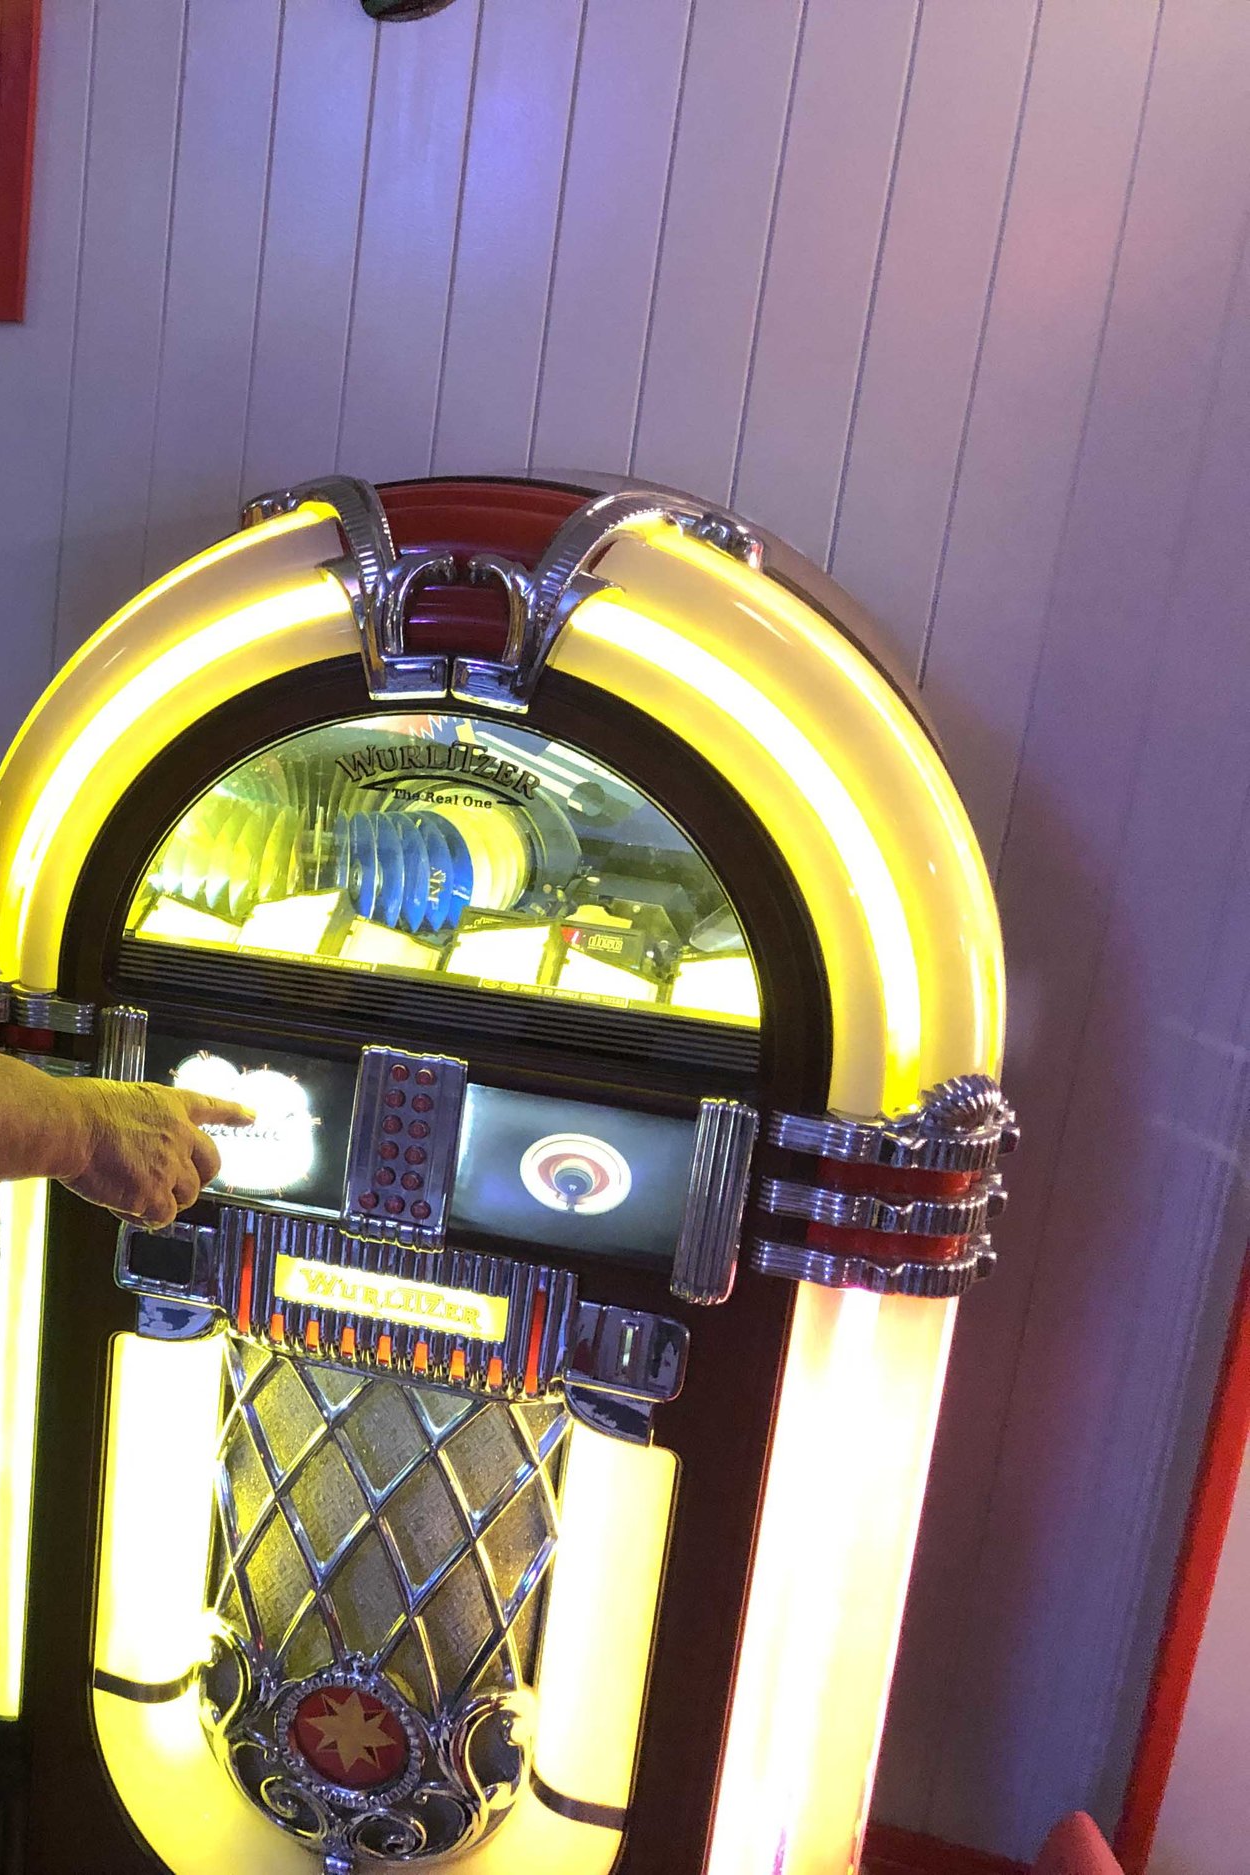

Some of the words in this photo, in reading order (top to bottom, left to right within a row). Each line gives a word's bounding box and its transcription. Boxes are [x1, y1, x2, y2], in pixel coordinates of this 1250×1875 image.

[334, 740, 541, 800] WURLITZER
[392, 786, 421, 802] The
[425, 791, 458, 806] Real
[463, 796, 492, 809] One
[300, 1268, 483, 1331] WURLITZER
